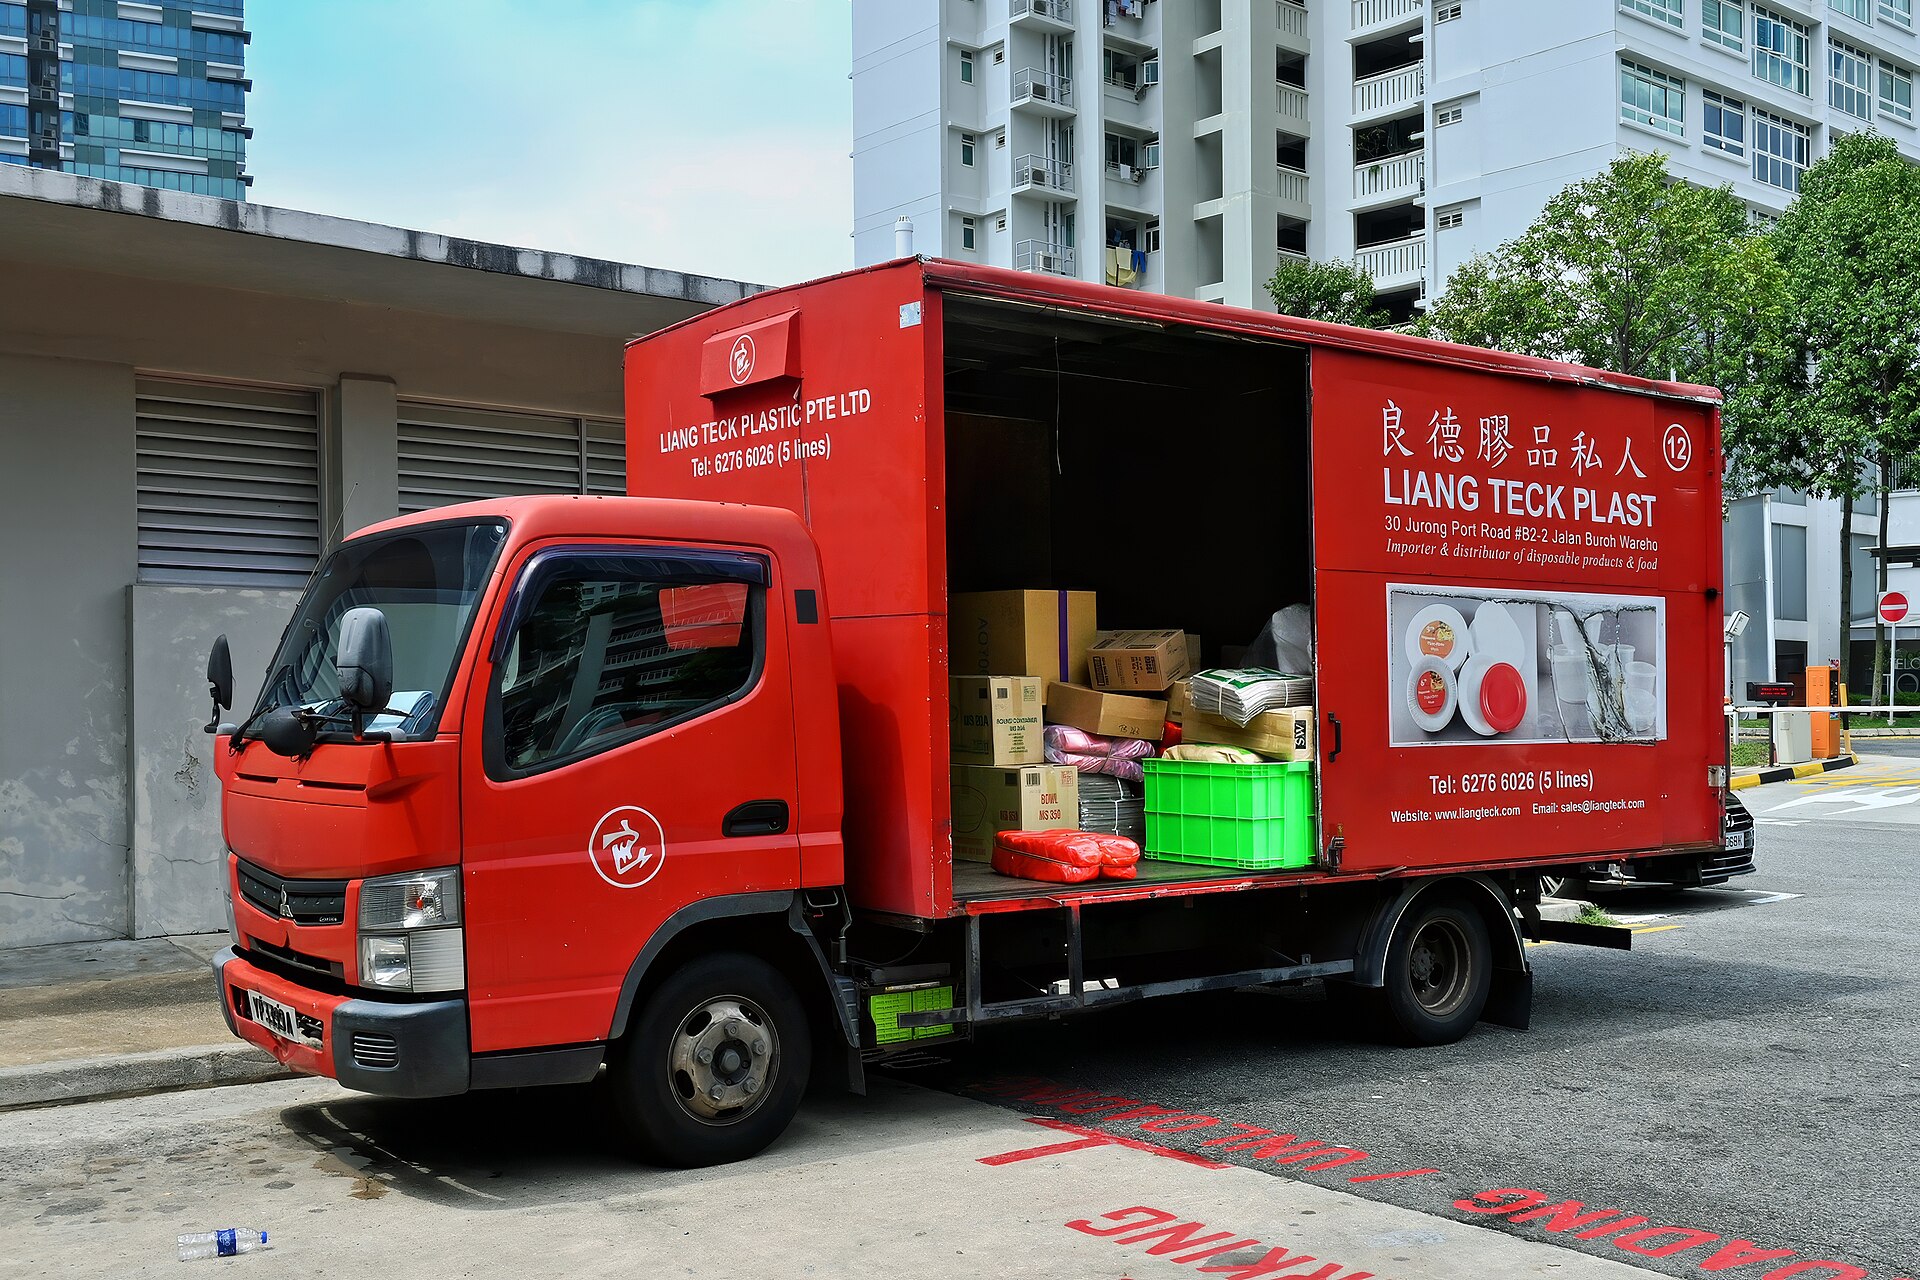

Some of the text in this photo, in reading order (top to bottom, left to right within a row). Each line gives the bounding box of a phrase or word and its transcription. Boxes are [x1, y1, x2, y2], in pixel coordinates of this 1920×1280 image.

[660, 388, 871, 453] LIANG TECK PLASTIC PTE LTD
[1382, 398, 1648, 479] 良德膠品私人
[691, 433, 831, 478] Tel: 6276 6026 (5 lines)
[1666, 435, 1687, 461] 12
[1383, 467, 1657, 527] LIANG TECK PLAST
[1385, 515, 1658, 552] 30 Jurong Port Road #B2-2 Jalan Buroh Wareho
[1386, 538, 1658, 572] Importer & distributor of disposable products & food
[1429, 769, 1594, 794] Tel: 6276 6026 (5 lines)
[1391, 799, 1645, 823] Website: www.liangteck.com Email: sales@liangteck.com
[1453, 1188, 1915, 1280] OADING
